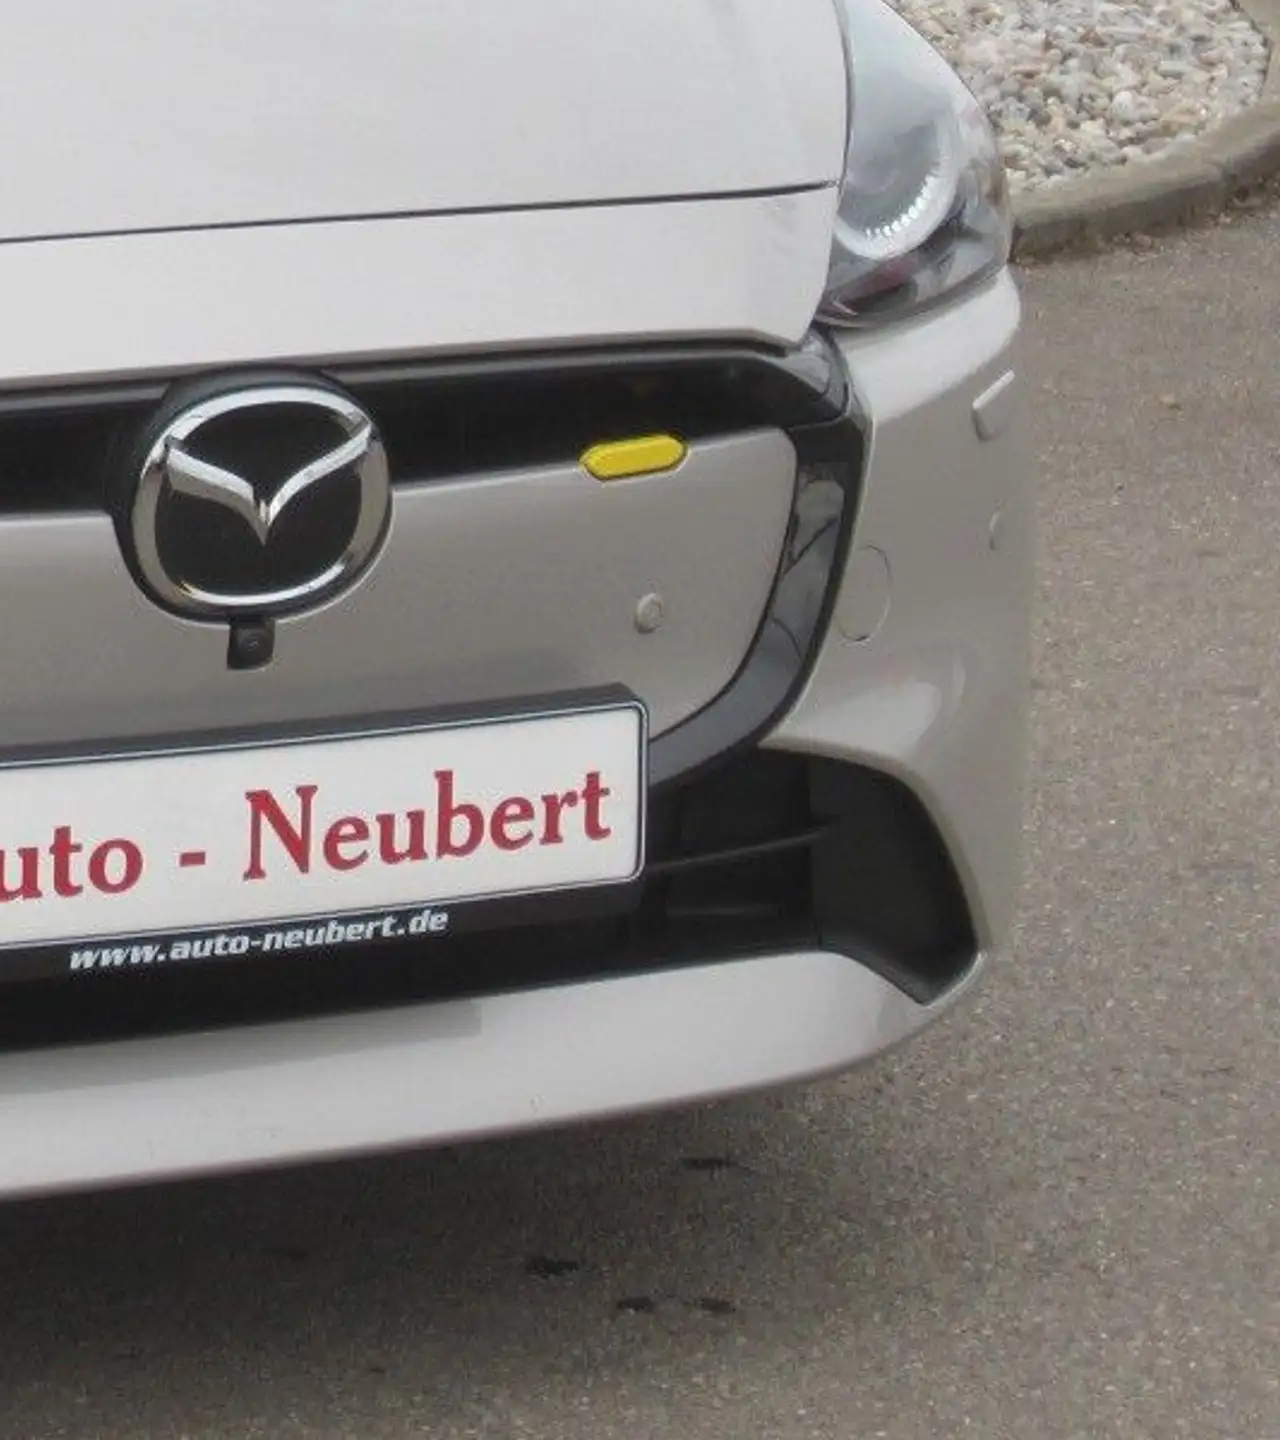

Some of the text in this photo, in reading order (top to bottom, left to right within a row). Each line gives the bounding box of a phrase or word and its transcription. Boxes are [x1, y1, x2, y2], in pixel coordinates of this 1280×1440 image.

[179, 851, 207, 867] -
[243, 770, 612, 881] Neubert
[69, 908, 449, 970] www.auto-neubert.de
